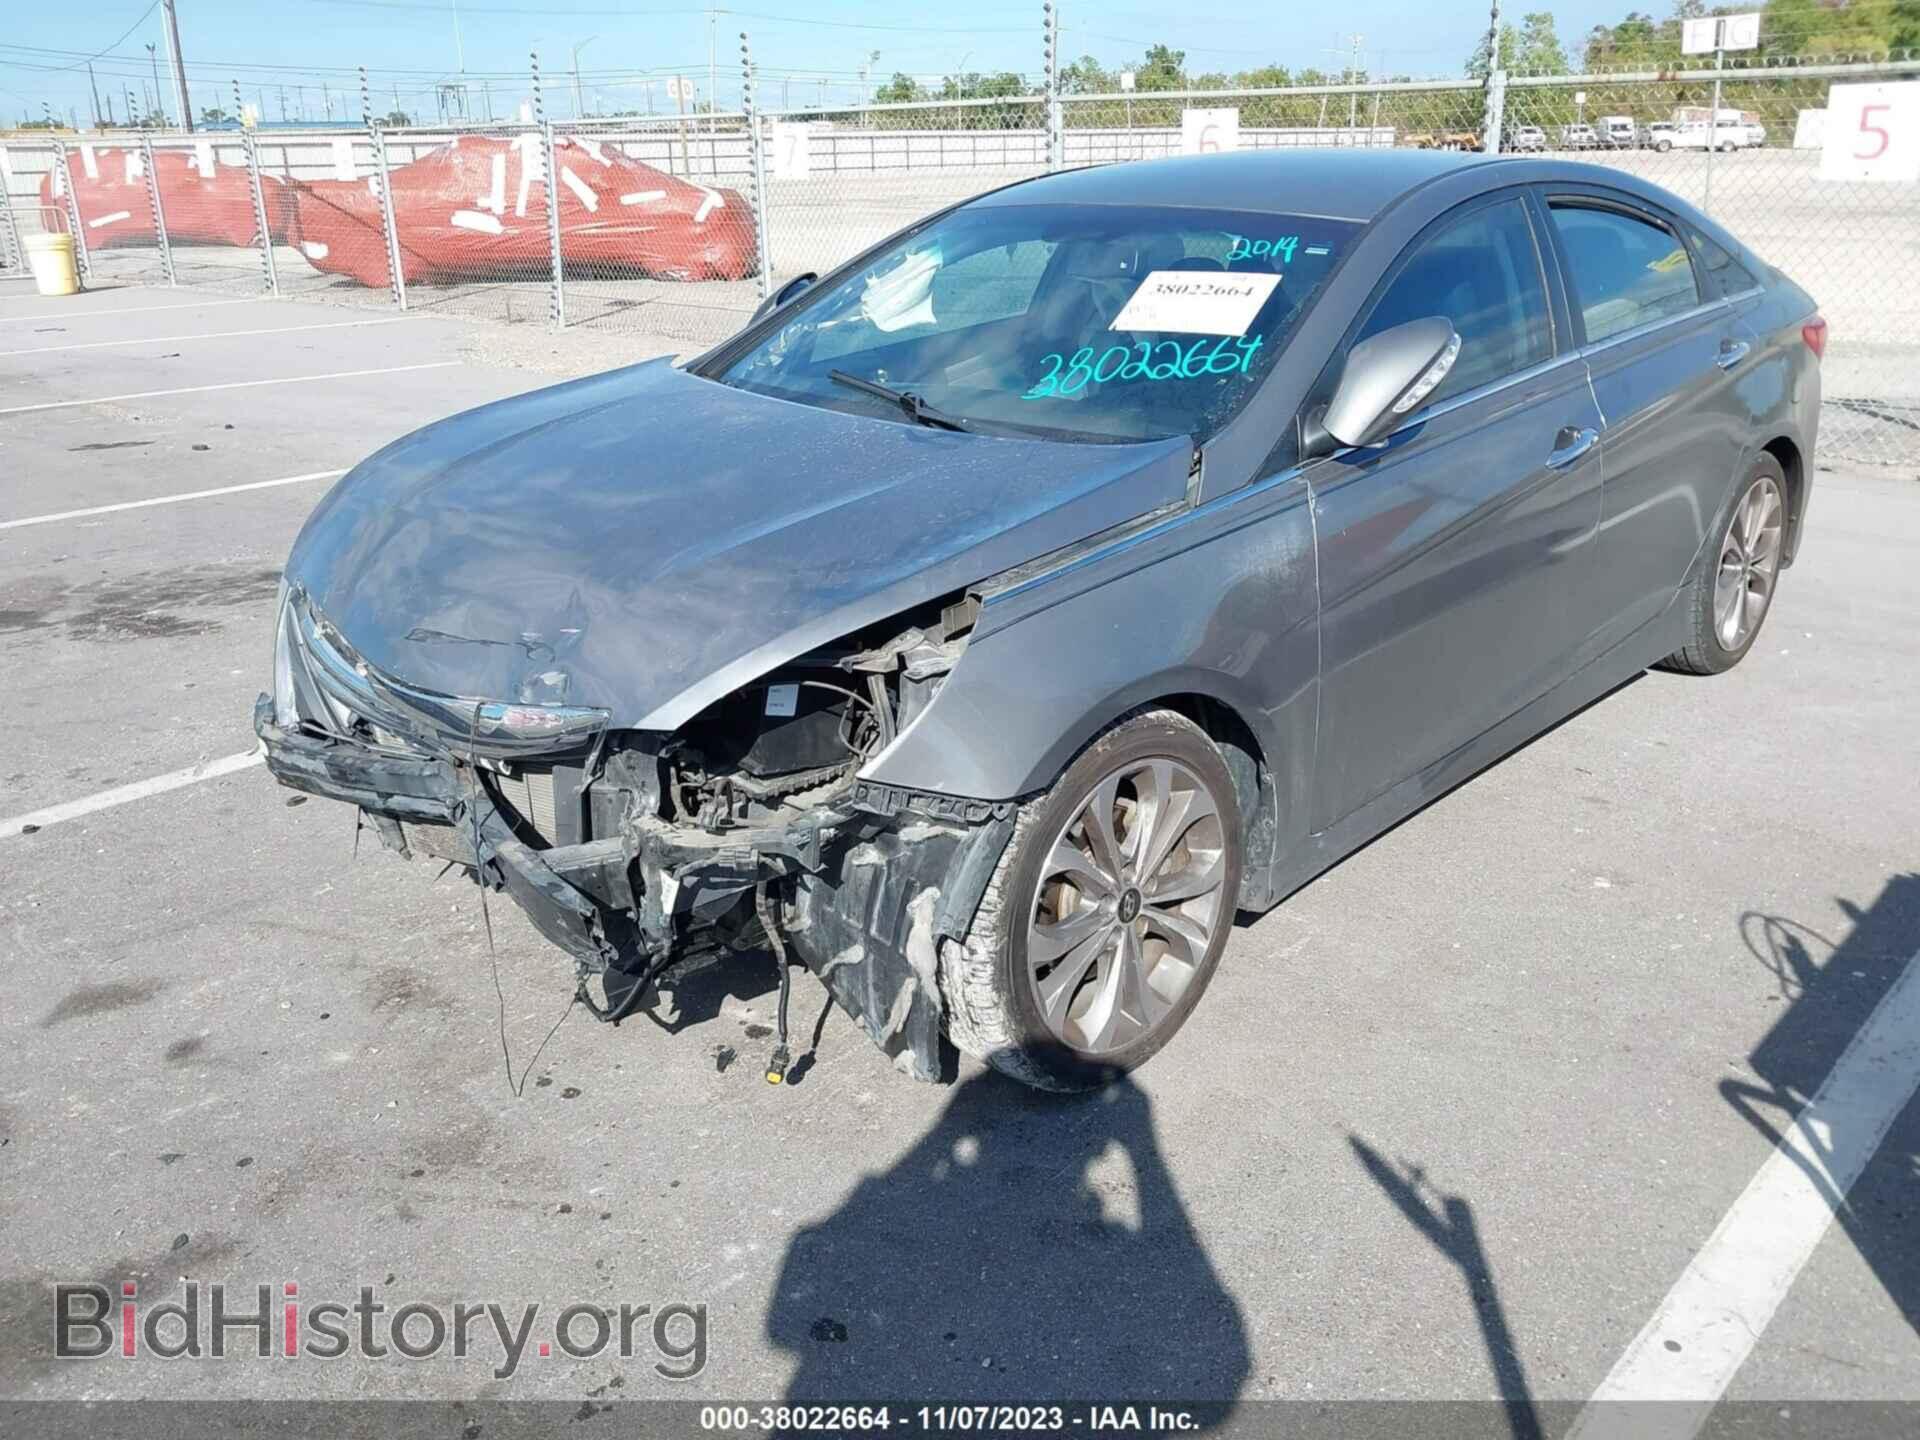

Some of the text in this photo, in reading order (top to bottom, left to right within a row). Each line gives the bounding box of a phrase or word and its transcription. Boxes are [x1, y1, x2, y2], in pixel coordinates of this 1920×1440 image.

[1853, 104, 1890, 160] 5
[1225, 235, 1299, 264] 2014
[1151, 282, 1255, 298] 38022664
[1020, 333, 1264, 400] 38022664
